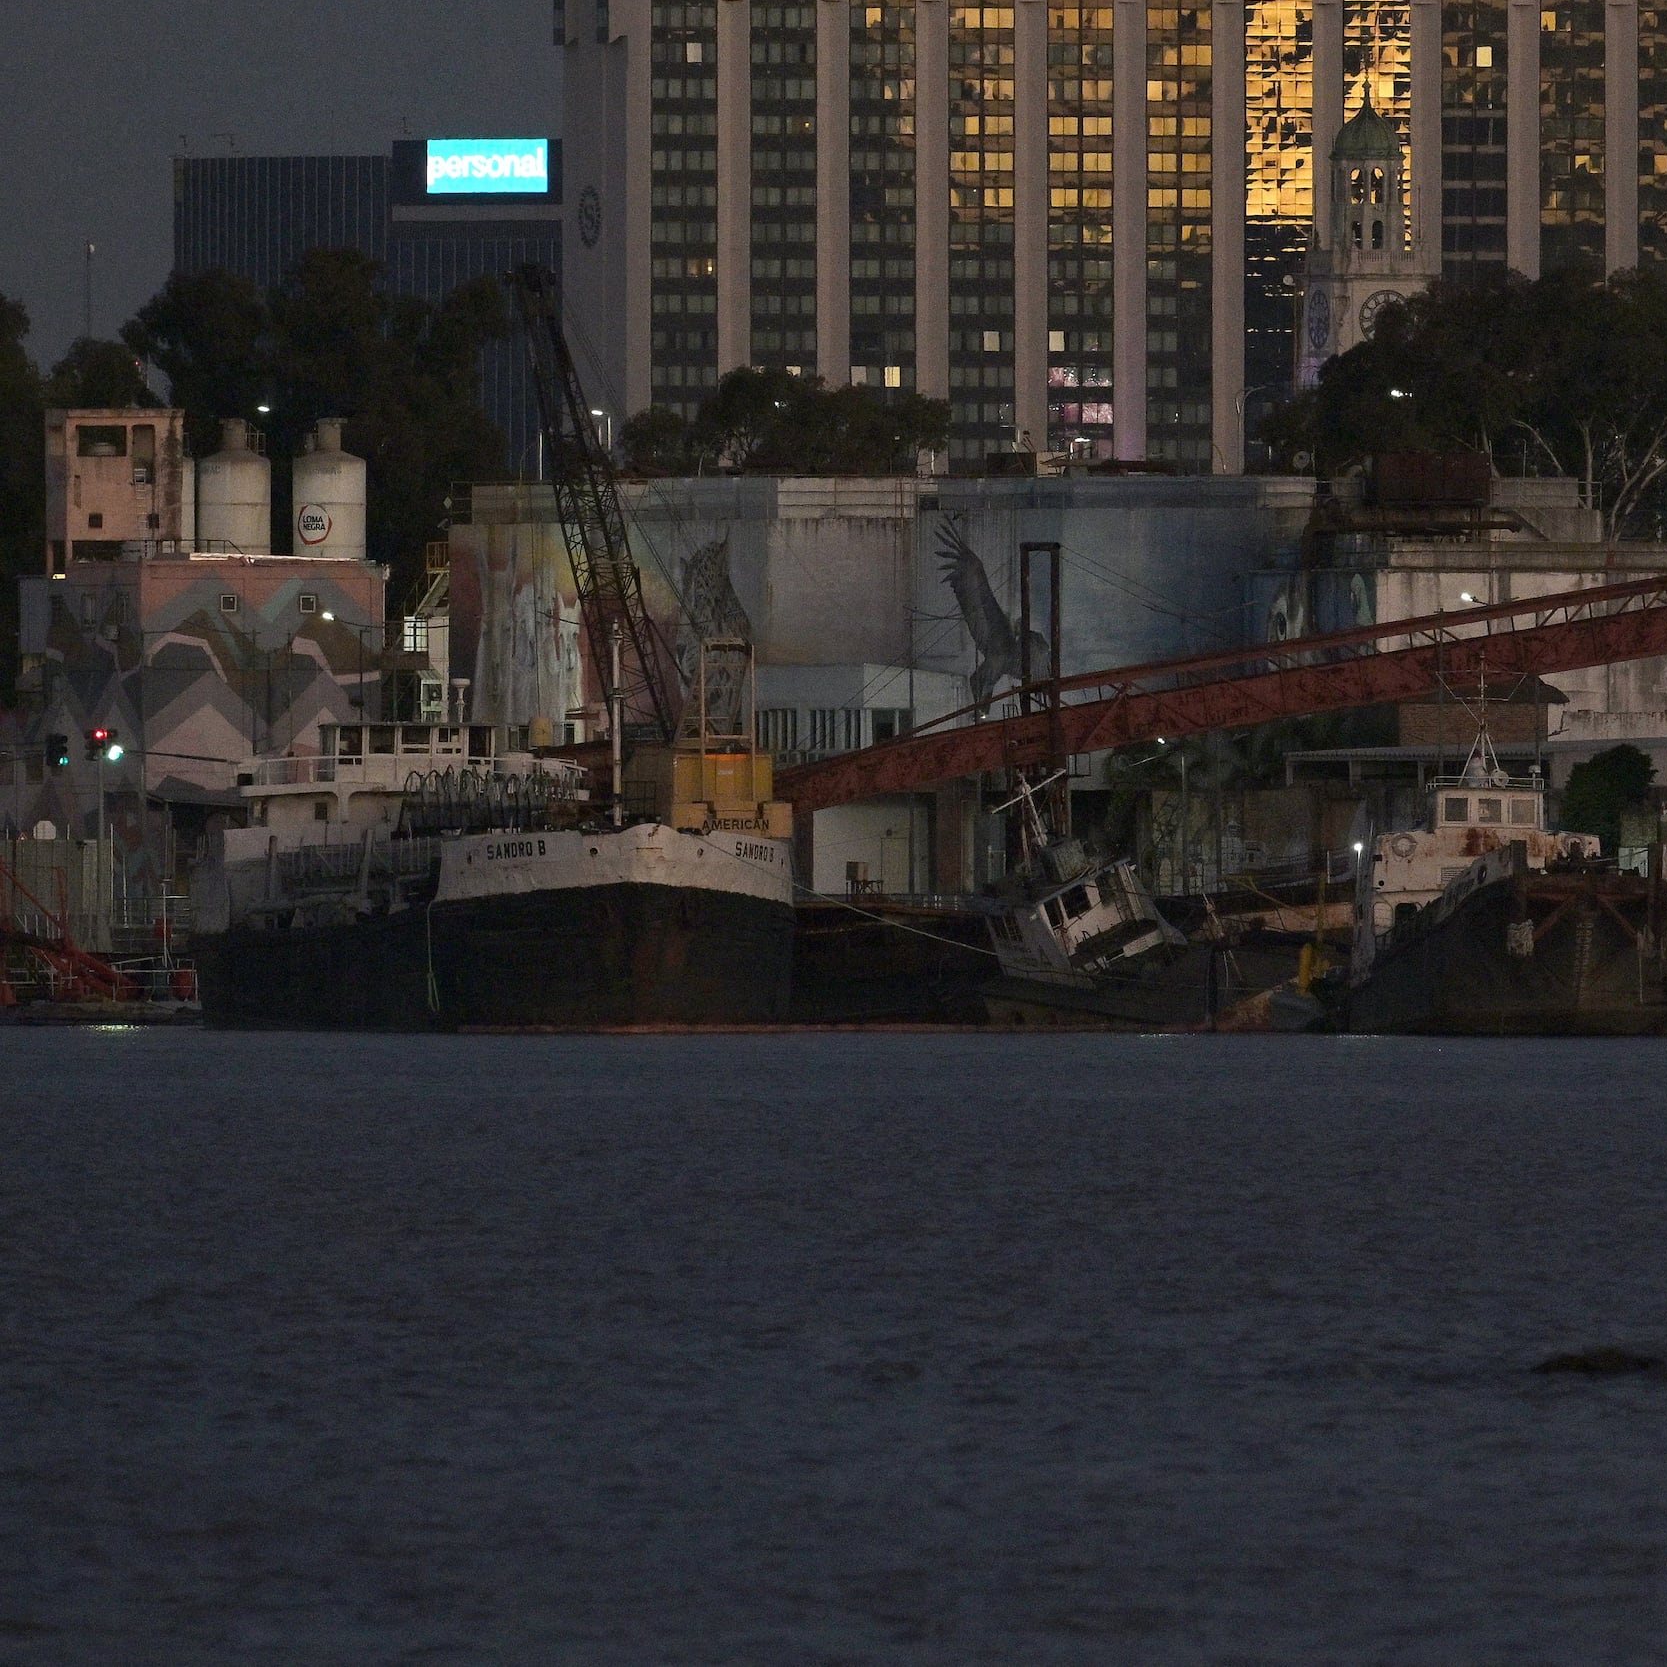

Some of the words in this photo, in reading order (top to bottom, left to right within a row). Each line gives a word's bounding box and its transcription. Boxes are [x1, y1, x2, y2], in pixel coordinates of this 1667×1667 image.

[427, 146, 548, 187] personal
[302, 515, 324, 523] LOMA
[302, 523, 326, 531] NEGRA
[701, 817, 770, 832] AMERICAN
[486, 842, 534, 861] SANDRO
[537, 839, 547, 856] B
[735, 841, 768, 861] SANDRO
